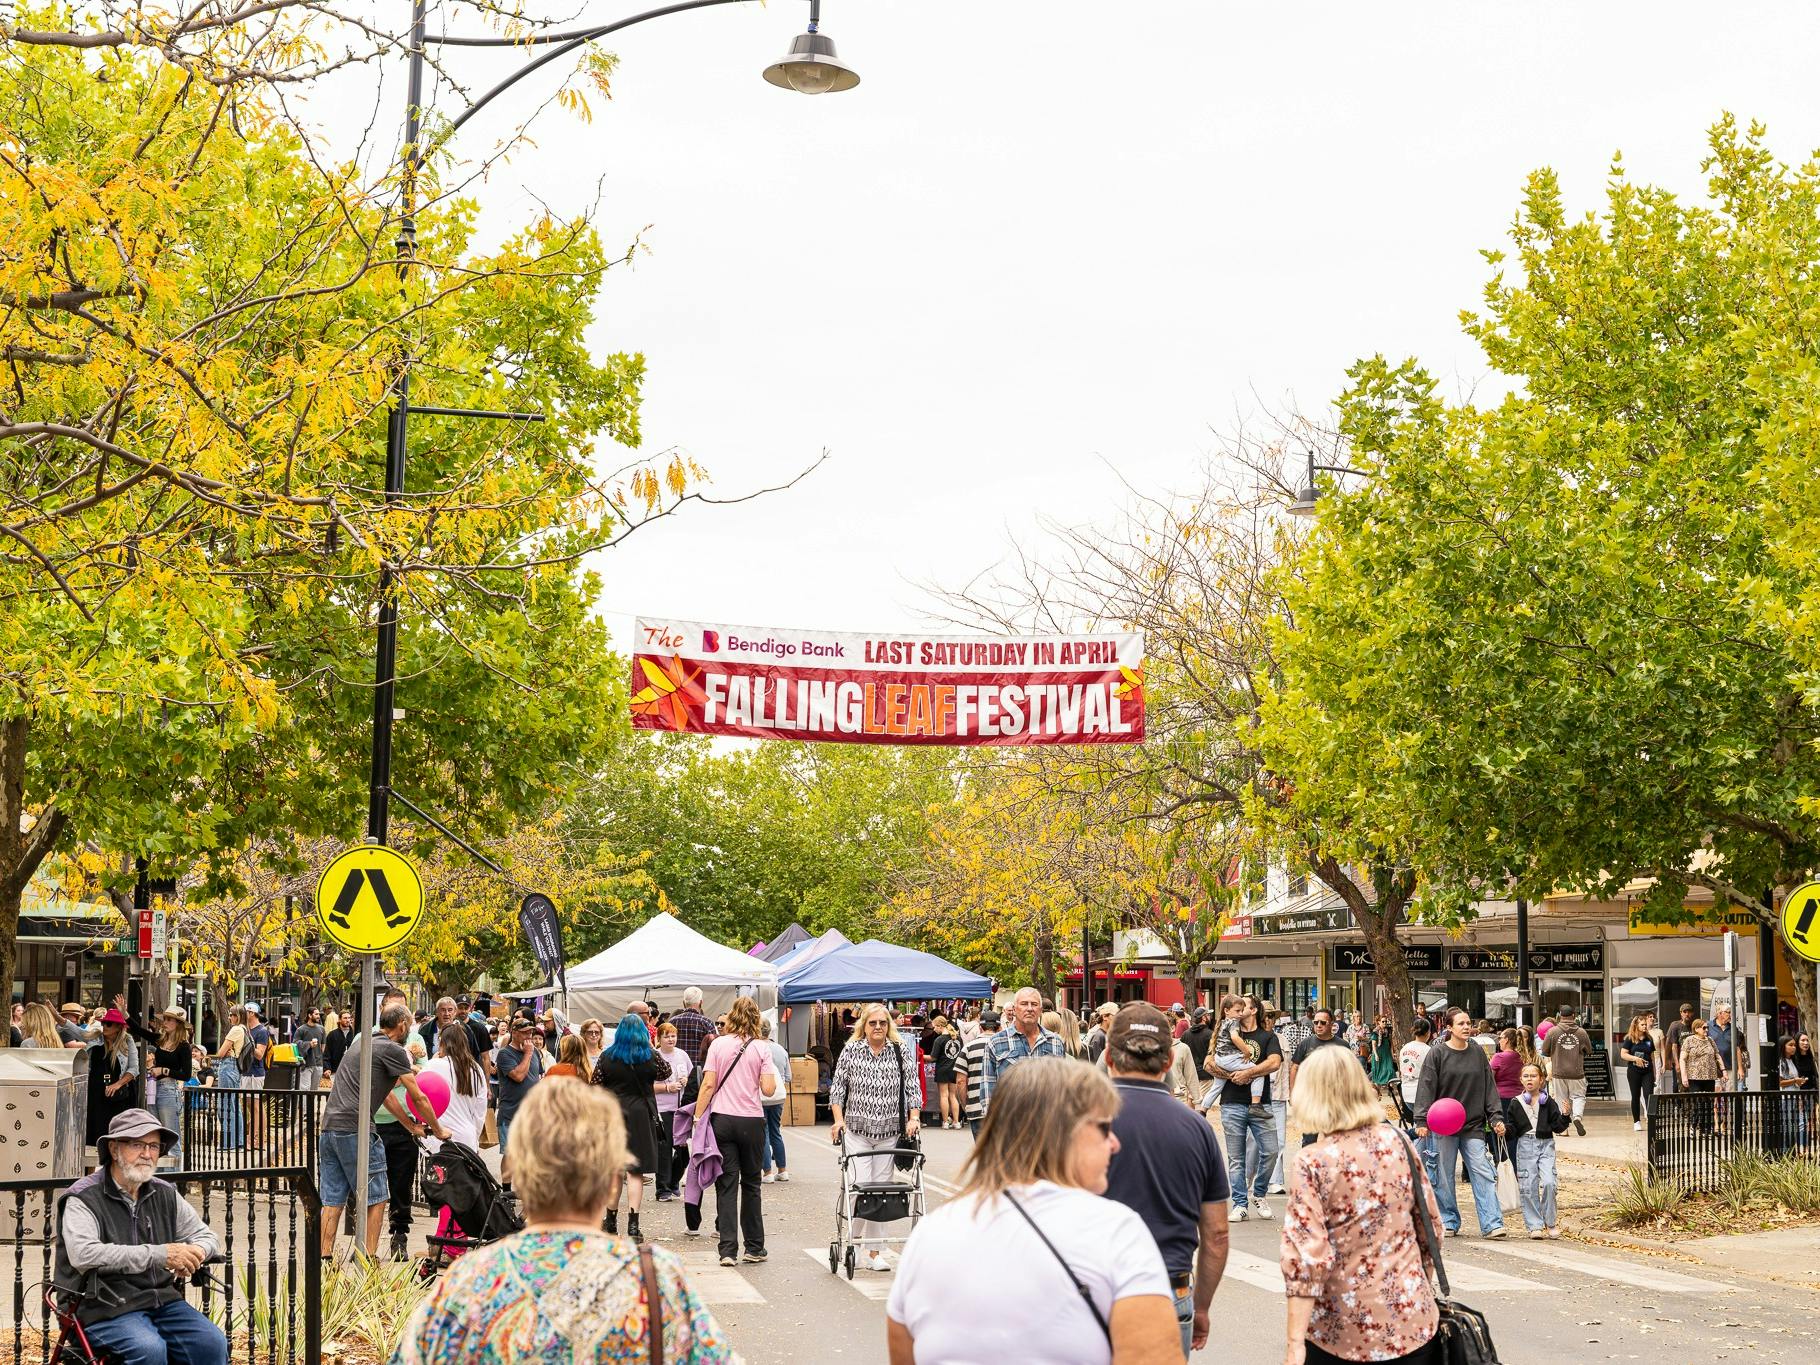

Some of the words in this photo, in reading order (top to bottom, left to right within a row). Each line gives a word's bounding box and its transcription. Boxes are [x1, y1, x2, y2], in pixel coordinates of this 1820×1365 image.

[643, 626, 684, 648] The
[728, 636, 797, 658] Bendigo
[802, 641, 845, 658] Bank
[864, 640, 916, 665] LAST
[920, 641, 1028, 666] SATURDAY
[1029, 641, 1056, 665] IN
[1060, 640, 1120, 665] APRIL
[704, 672, 862, 734] FALLING
[863, 682, 956, 736] LEAF
[120, 939, 137, 953] TOILE
